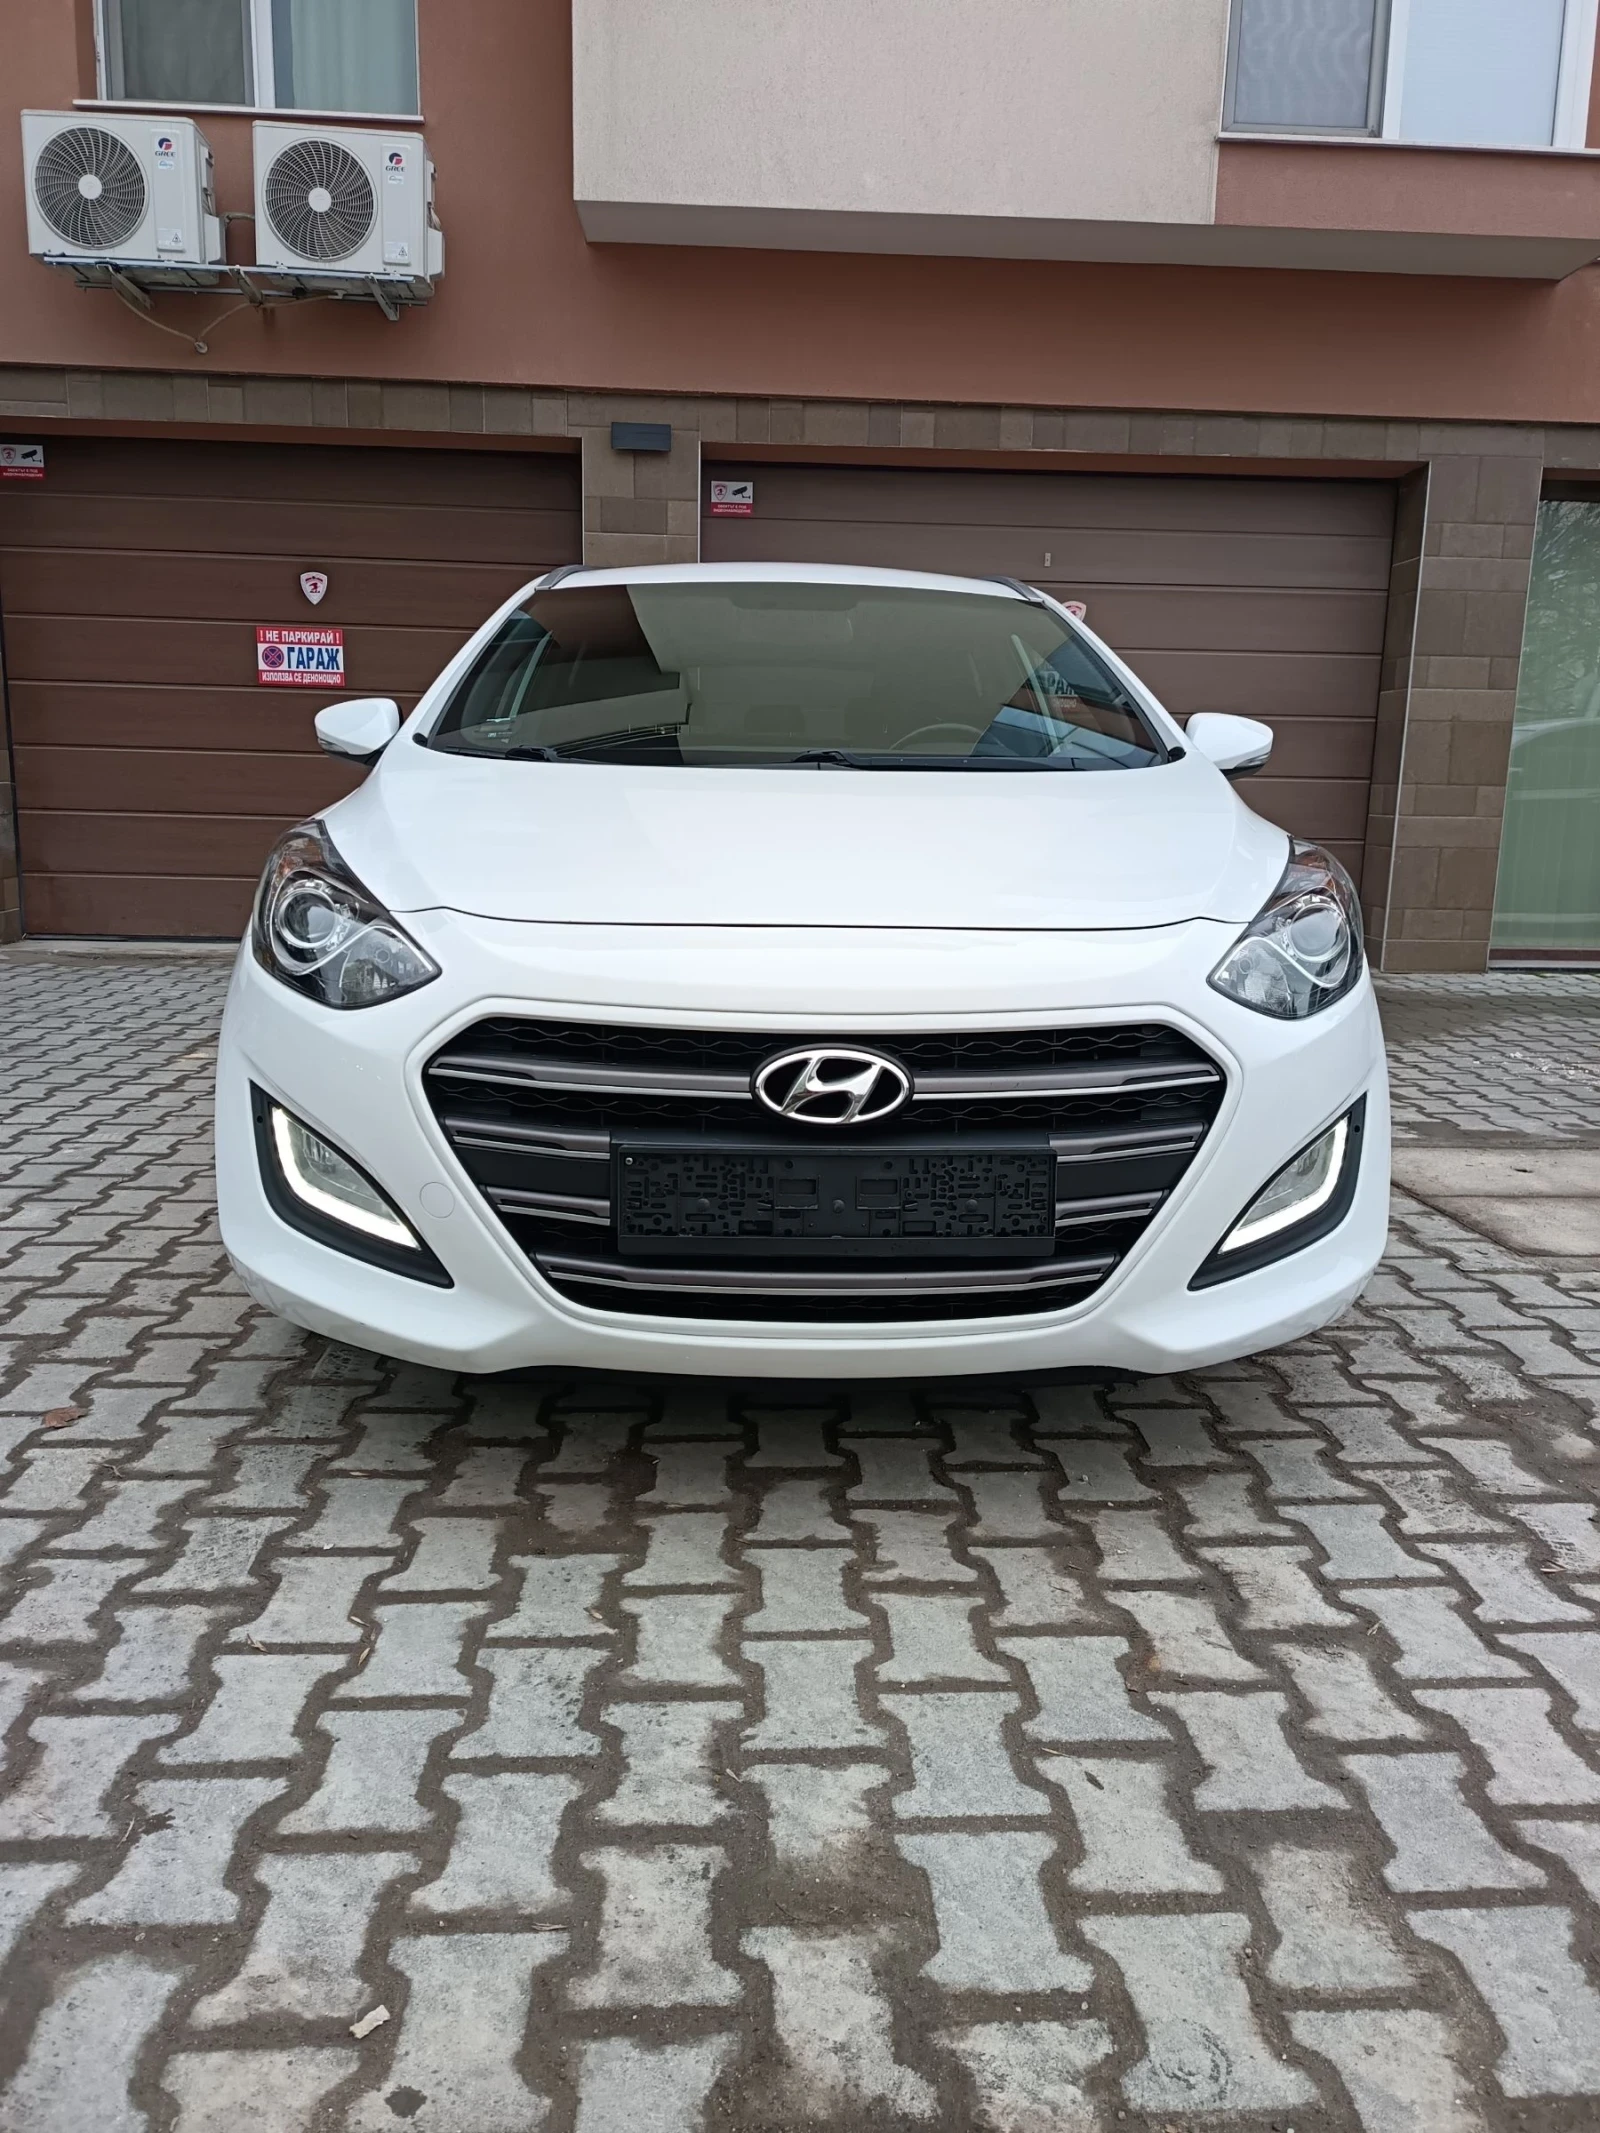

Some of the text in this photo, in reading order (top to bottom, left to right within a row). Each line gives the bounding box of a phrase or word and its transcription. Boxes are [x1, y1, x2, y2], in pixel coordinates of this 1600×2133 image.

[154, 150, 176, 158] GREE
[385, 165, 406, 173] GREE
[266, 630, 279, 641] НЕ
[281, 630, 333, 643] ПАРКИРАЙ
[287, 647, 340, 670] ГАРАЖ
[294, 673, 302, 683] СЕ
[303, 673, 341, 684] ДЕНОНОЩНО
